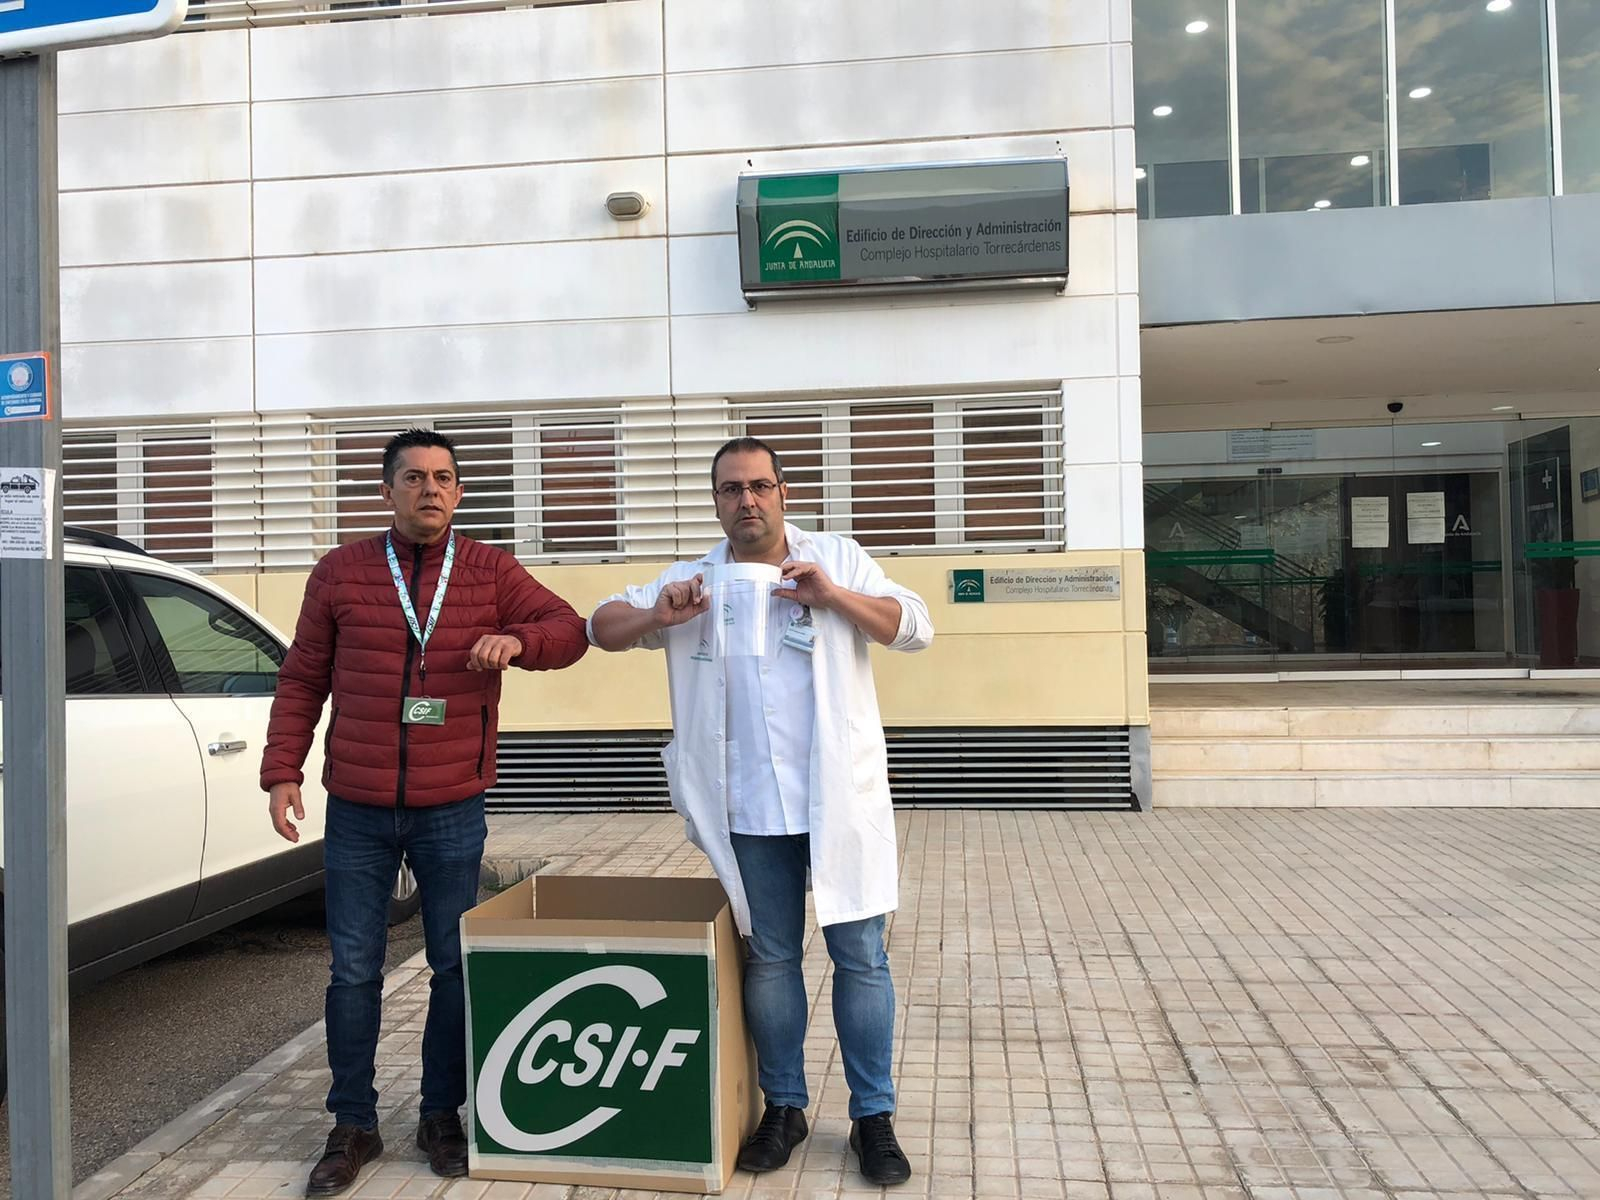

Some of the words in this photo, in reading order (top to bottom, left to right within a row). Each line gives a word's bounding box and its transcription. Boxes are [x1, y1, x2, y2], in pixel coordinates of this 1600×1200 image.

[846, 228, 887, 243] Edificio
[891, 227, 905, 240] de
[909, 224, 962, 240] Dirección
[966, 226, 973, 240] y
[976, 219, 1062, 236] Administración
[860, 246, 912, 263] Complejo
[914, 243, 980, 261] Hospitalario
[984, 240, 1062, 256] Torrecárdenas
[765, 262, 786, 271] JUNTA
[788, 261, 798, 270] DE
[990, 576, 1014, 585] Edificio
[1015, 576, 1024, 584] de
[1064, 574, 1114, 583] Administración
